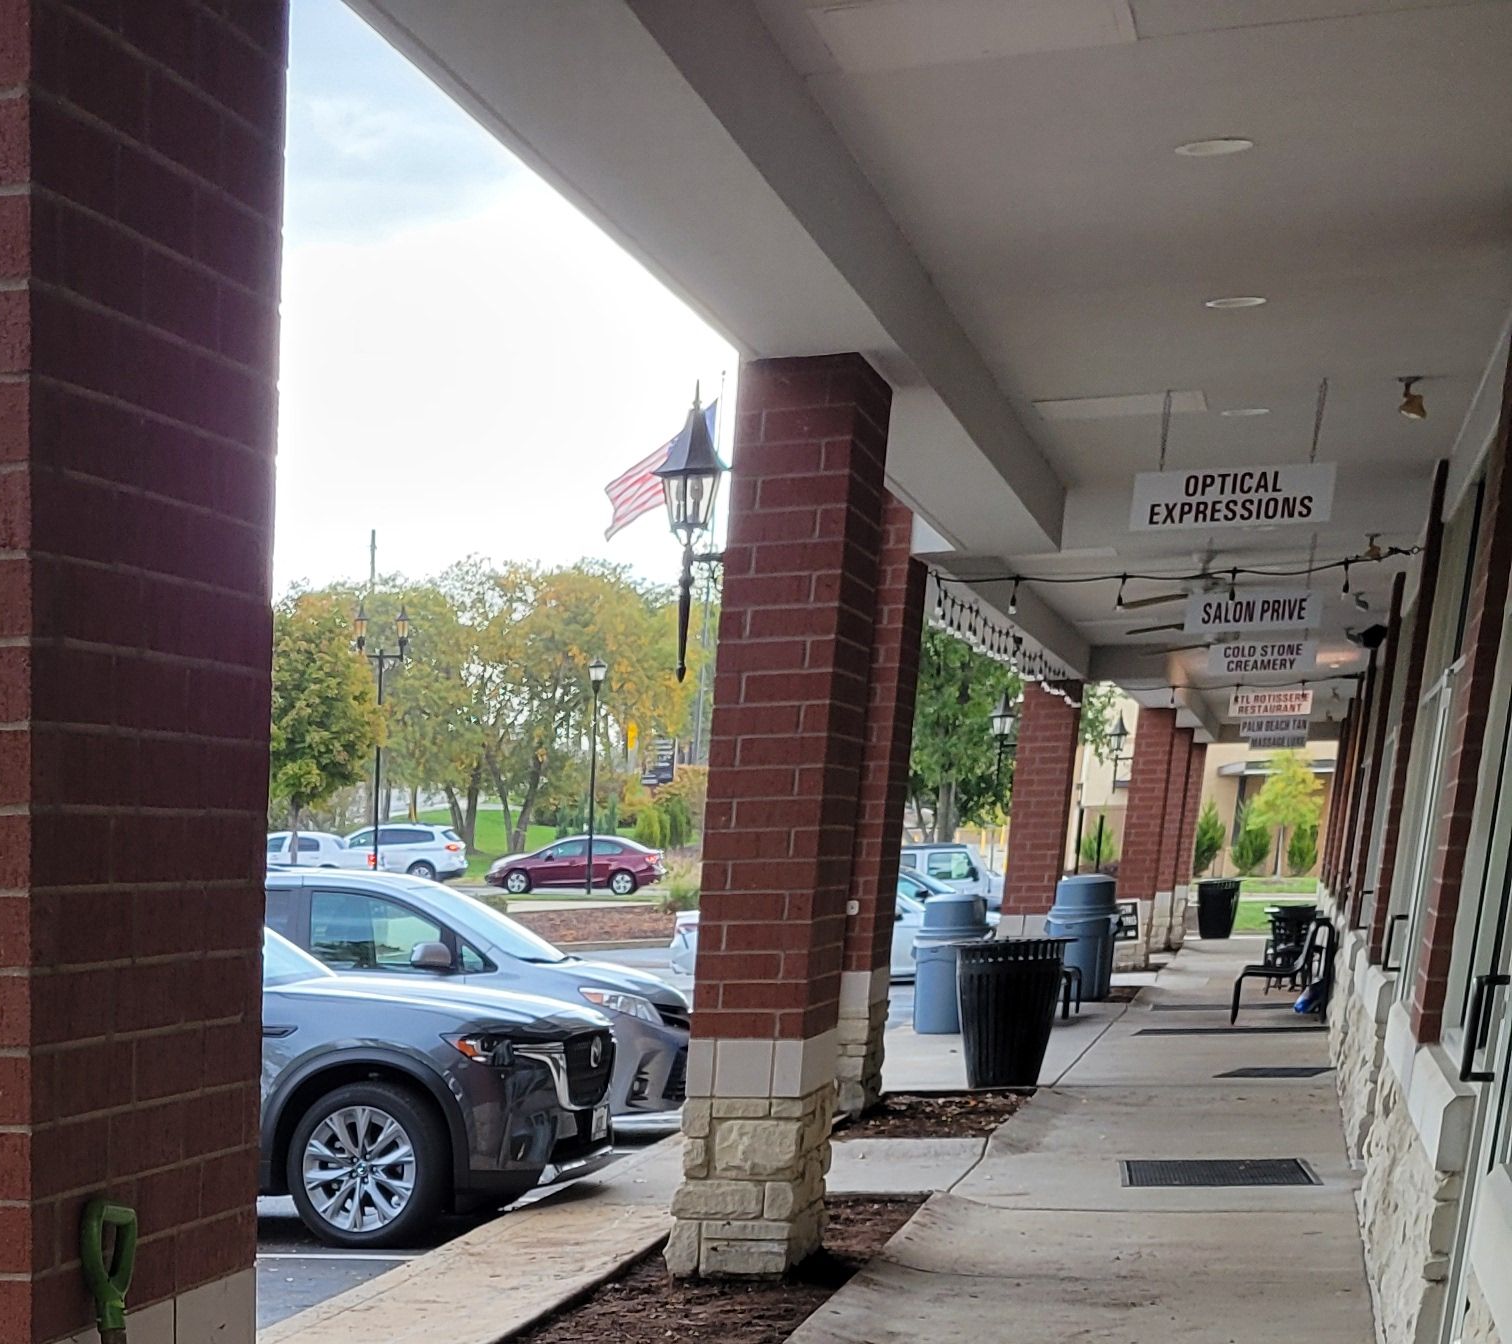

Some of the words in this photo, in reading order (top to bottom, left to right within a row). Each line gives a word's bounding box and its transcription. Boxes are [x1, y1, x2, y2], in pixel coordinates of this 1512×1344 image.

[1184, 471, 1283, 497] OPTICAL
[1148, 496, 1314, 525] EXPRESSIONS
[1201, 600, 1255, 624] SALON
[1260, 598, 1308, 622] PRIVE
[1223, 645, 1256, 658] COLD
[1260, 643, 1303, 657] STONE
[1226, 658, 1296, 672] CREAMERY
[1238, 704, 1302, 714] RESTAURANT
